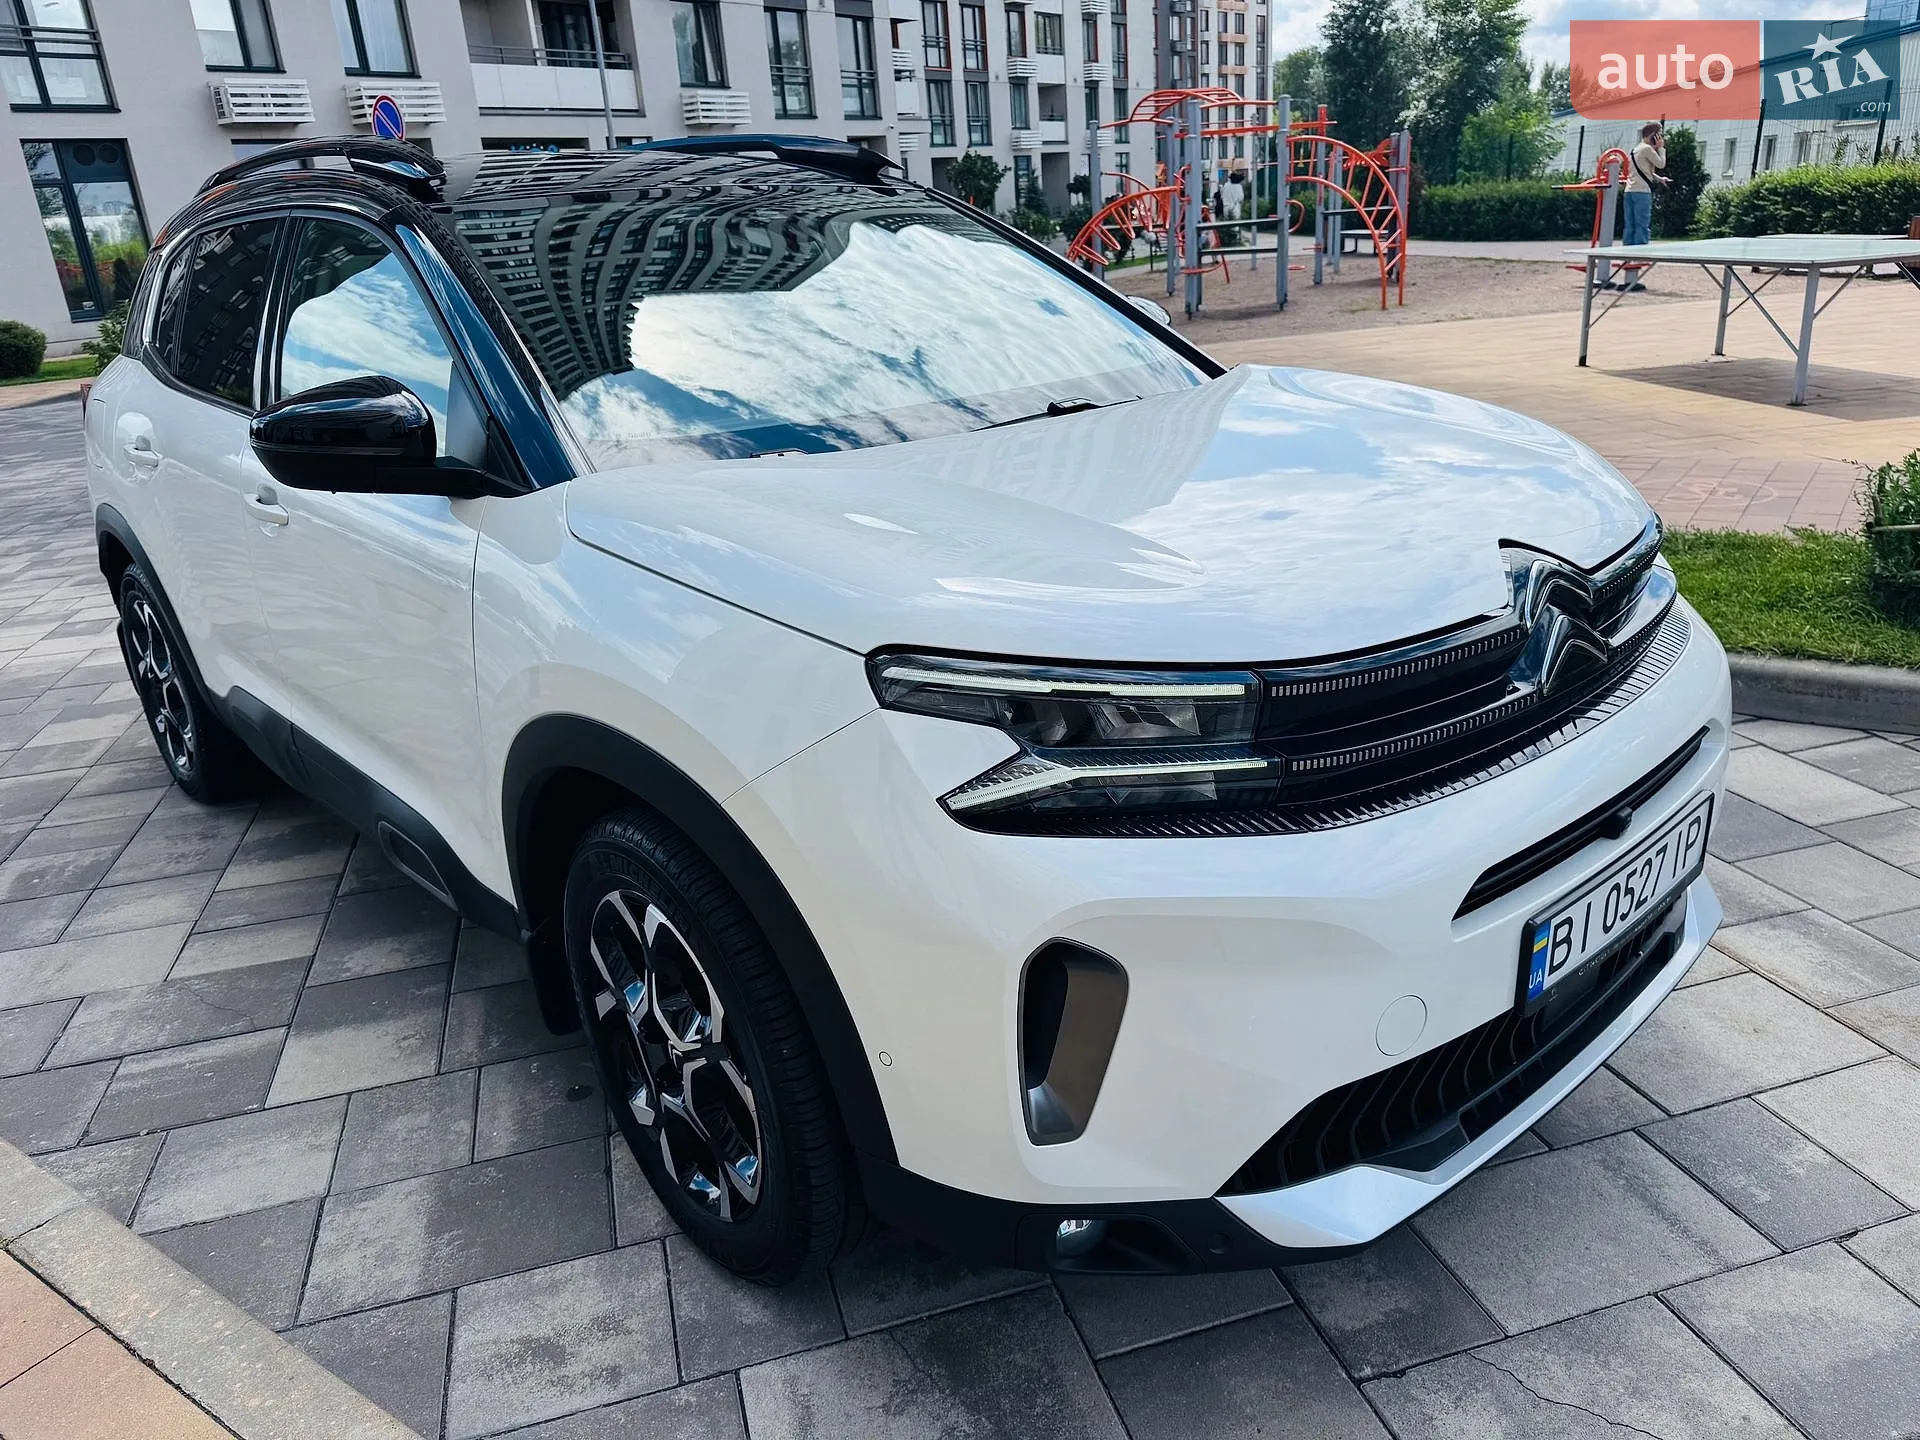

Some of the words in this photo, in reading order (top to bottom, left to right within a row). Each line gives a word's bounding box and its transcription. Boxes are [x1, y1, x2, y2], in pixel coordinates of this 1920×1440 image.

[1547, 901, 1592, 977] BI
[1602, 842, 1669, 935] 0527
[1672, 815, 1702, 879] IP
[1528, 968, 1543, 990] UA
